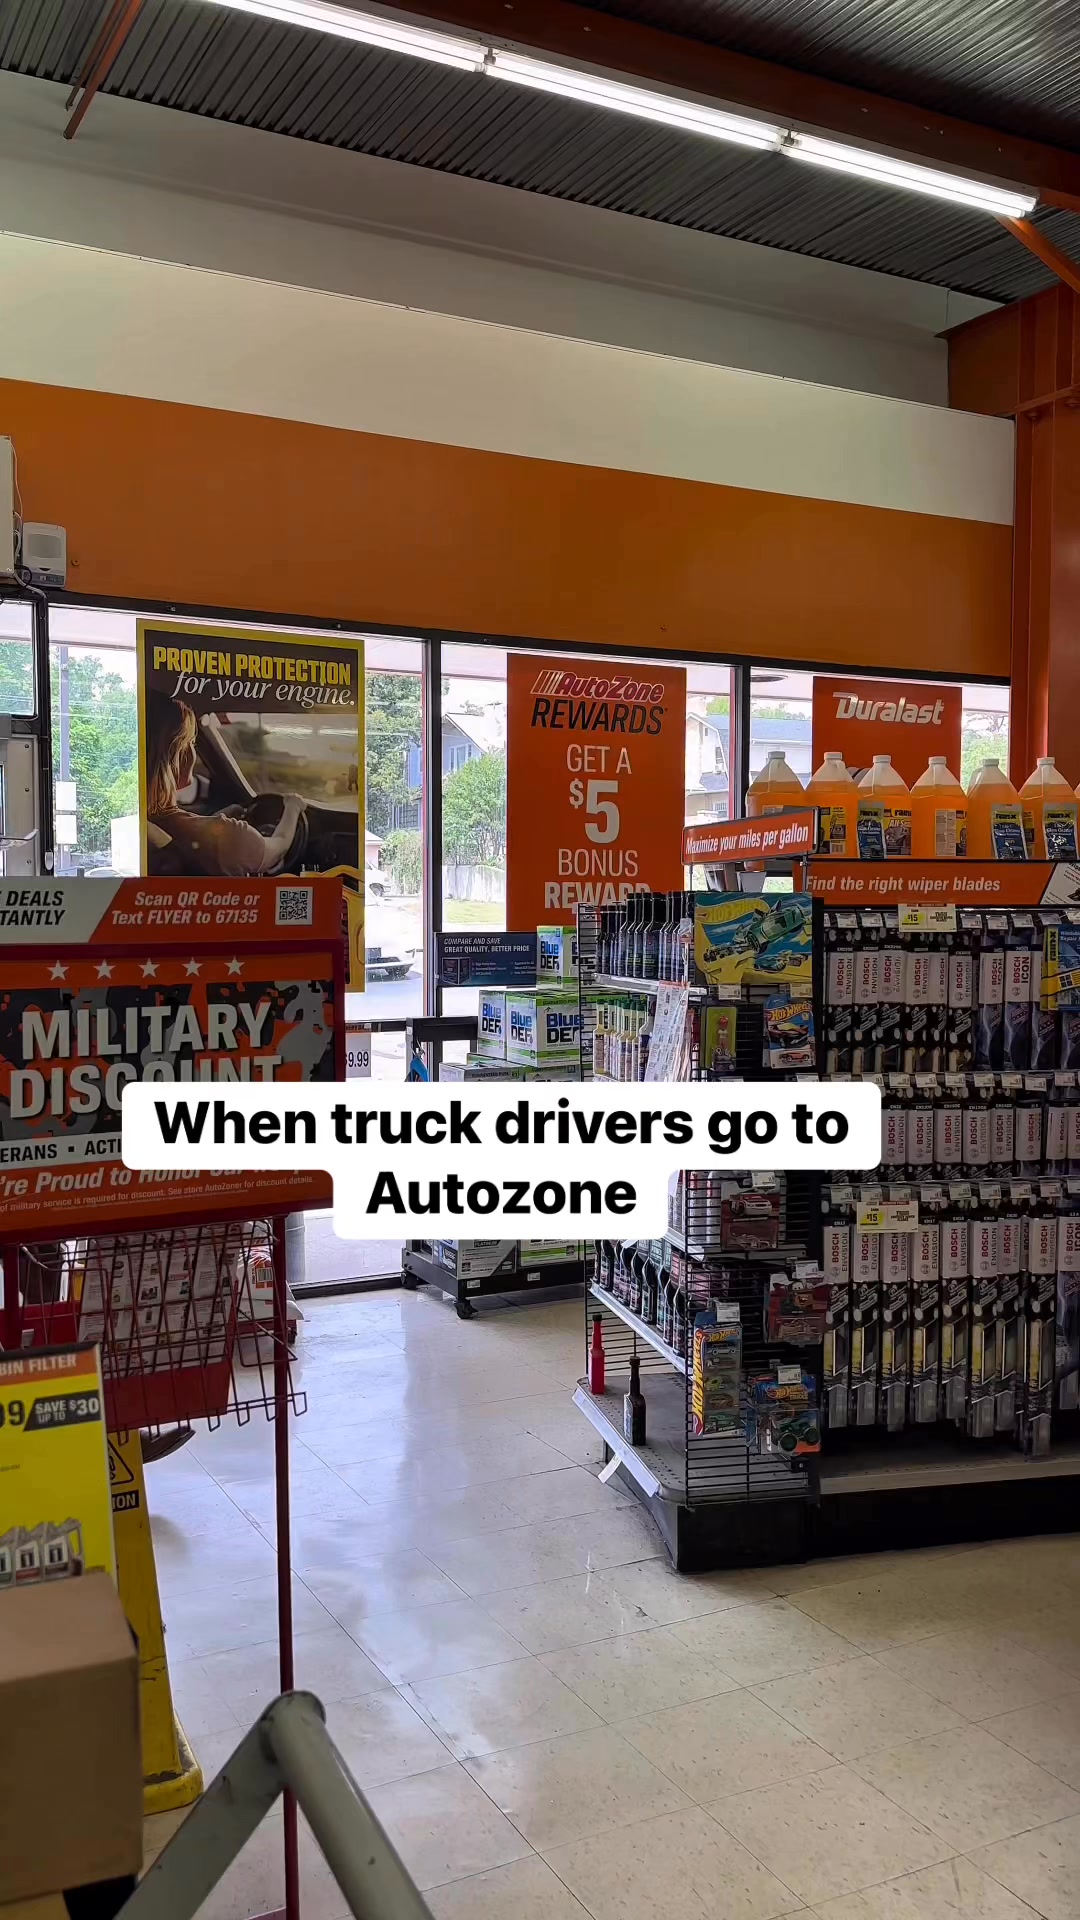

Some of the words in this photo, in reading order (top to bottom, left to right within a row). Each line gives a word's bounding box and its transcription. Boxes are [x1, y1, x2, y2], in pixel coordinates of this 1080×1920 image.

[153, 646, 235, 676] PROVEN
[236, 654, 351, 685] PROTECTION
[170, 670, 210, 698] for
[212, 676, 270, 701] your
[275, 683, 355, 709] engine.
[553, 670, 665, 704] AutoZone
[531, 698, 664, 735] REWARDS
[833, 692, 944, 725] Duralast
[567, 744, 610, 773] GET
[616, 747, 632, 774] A
[569, 779, 620, 844] $5
[686, 836, 718, 854] Maximize
[719, 833, 737, 855] your
[739, 828, 761, 848] miles
[762, 831, 777, 851] per
[779, 823, 809, 849] gallon
[558, 849, 638, 876] BONUS
[806, 875, 835, 891] Find
[839, 876, 864, 891] the
[868, 875, 903, 896] right
[908, 876, 949, 896] wiper
[953, 875, 1001, 892] blades
[6, 890, 64, 906] DEALS
[135, 892, 174, 907] Scan
[177, 892, 200, 908] QR
[202, 892, 239, 907] Code
[243, 893, 260, 906] or
[0, 910, 66, 926] TANTLY
[112, 911, 144, 926] Text
[147, 911, 191, 925] FLYER
[195, 912, 211, 925] to
[215, 910, 259, 924] 67135
[540, 941, 559, 955] Blue
[540, 955, 559, 970] DEF
[837, 958, 845, 986] BOSCH
[884, 955, 892, 983] BOSCH
[1013, 956, 1021, 983] BOSCH
[1021, 956, 1030, 984] ICON
[482, 1003, 501, 1019] Blue
[510, 1011, 532, 1027] Blue
[21, 1001, 271, 1060] MILITARY
[482, 1019, 501, 1034] DEF
[511, 1025, 533, 1043] DEF
[0, 1144, 57, 1163] ERANS
[35, 1167, 104, 1194] Proud
[109, 1166, 131, 1186] to
[9, 1199, 41, 1211] military
[43, 1197, 72, 1207] service
[74, 1196, 81, 1205] is
[83, 1193, 115, 1205] required
[117, 1191, 130, 1201] for
[131, 1188, 166, 1200] discount.
[184, 1185, 203, 1195] store
[205, 1181, 242, 1193] AutoZoner
[244, 1181, 254, 1190] for
[256, 1177, 287, 1188] discount
[866, 1213, 878, 1222] $15
[29, 1353, 76, 1374] FILTER
[35, 1400, 67, 1413] SAVE
[70, 1396, 99, 1416] $30
[38, 1413, 53, 1423] UP
[53, 1411, 65, 1421] TO
